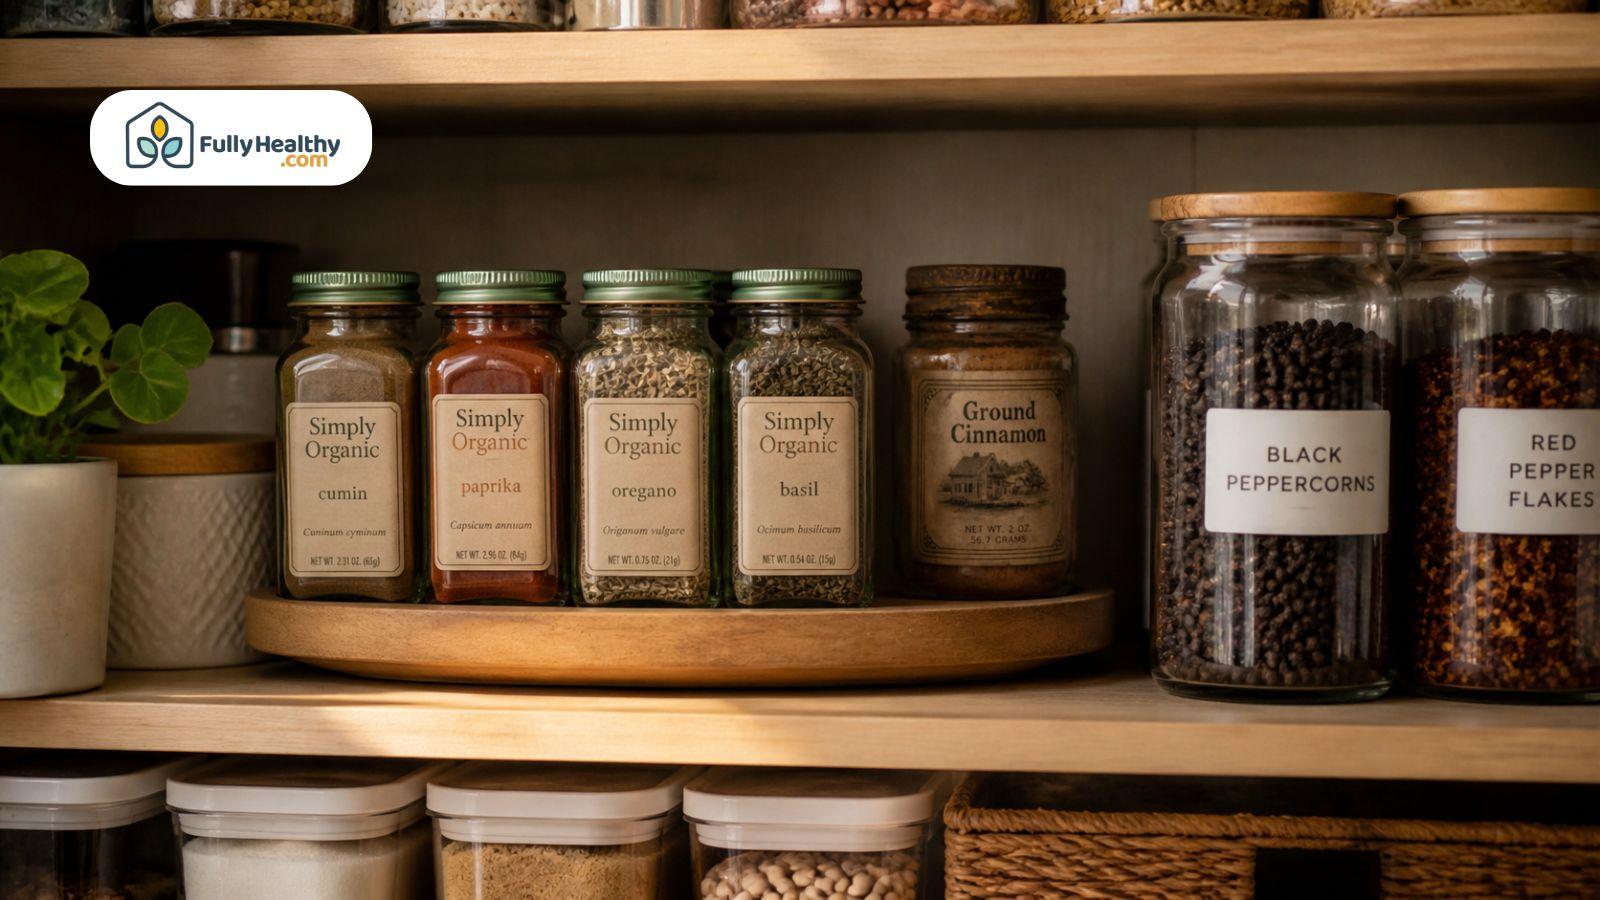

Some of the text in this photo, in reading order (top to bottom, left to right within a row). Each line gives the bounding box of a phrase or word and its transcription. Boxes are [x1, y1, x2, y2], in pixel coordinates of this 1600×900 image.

[963, 400, 1036, 421] Ground
[309, 416, 376, 441] Simply
[456, 408, 525, 433] Simply
[609, 412, 678, 437] Simply
[764, 411, 835, 436] Simply
[951, 424, 1046, 444] Cinnamon
[1531, 434, 1577, 451] RED
[305, 440, 380, 464] Organic
[452, 432, 528, 456] Organic
[604, 436, 681, 460] Organic
[759, 435, 838, 459] Organic
[1267, 446, 1342, 463] BLACK
[1509, 462, 1596, 479] PEPPER
[461, 477, 522, 498] paprika
[780, 481, 819, 496] basil
[1226, 475, 1376, 492] PEPPERCORNS
[318, 486, 368, 500] cumin
[611, 486, 677, 502] oregano
[1509, 491, 1595, 508] FLAKES
[345, 528, 387, 539] cyminum
[450, 520, 493, 532] Capsicum
[651, 525, 686, 537] vulgare
[757, 524, 841, 534] Ocimum basilicum
[965, 524, 1032, 534] NET WT. 2 OZ.
[995, 535, 1026, 544] GRAMS
[310, 556, 322, 566] NET
[336, 556, 350, 566] 2.31
[351, 556, 361, 566] OZ.
[456, 550, 468, 560] NET
[469, 550, 481, 560] WT.
[482, 550, 497, 560] 2.96
[498, 550, 507, 560] OZ.
[608, 555, 620, 565] NET
[622, 555, 634, 565] WT.
[635, 555, 650, 565] 0.75
[652, 555, 662, 565] OZ.
[762, 554, 774, 565] NET
[776, 554, 789, 564] WT.
[790, 554, 805, 564] 0.54
[806, 554, 816, 564] OZ.
